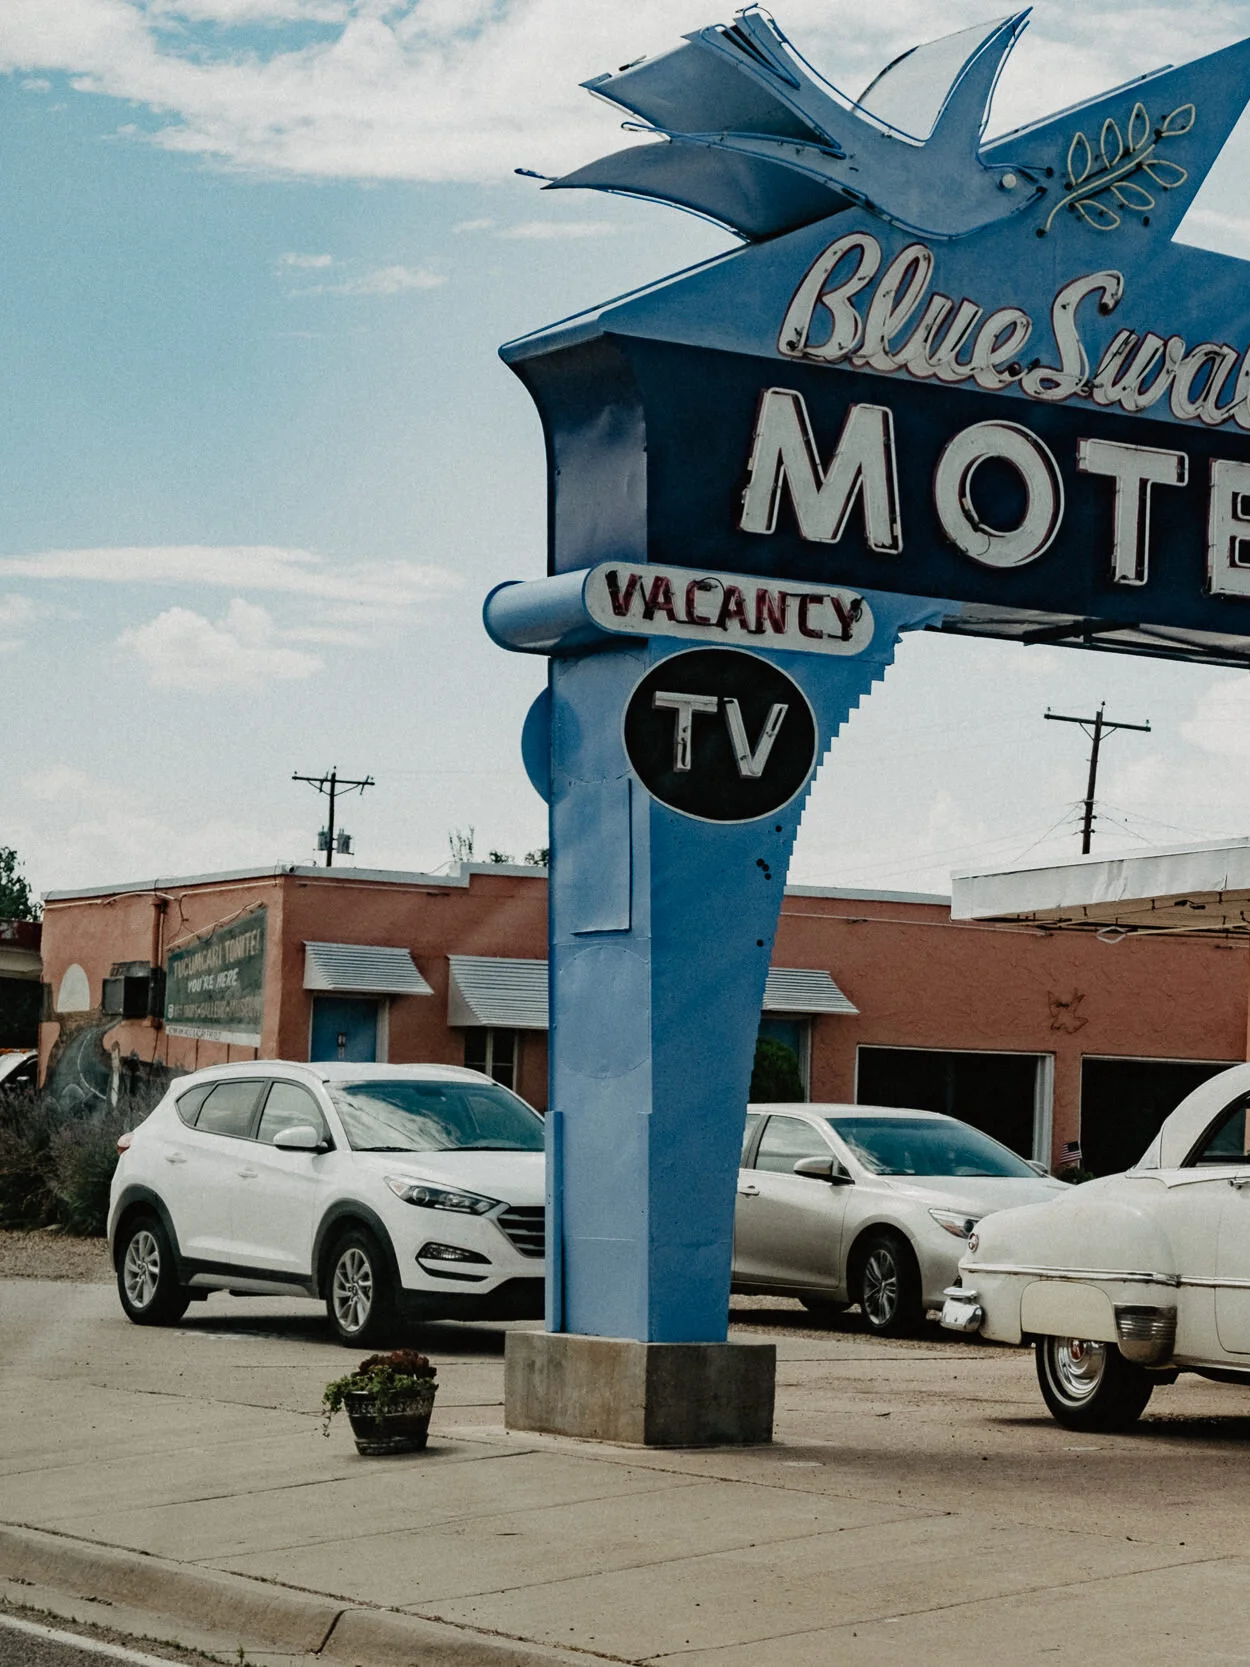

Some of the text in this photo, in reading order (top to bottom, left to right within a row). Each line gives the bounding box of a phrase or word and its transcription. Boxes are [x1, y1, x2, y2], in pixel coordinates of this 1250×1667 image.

[776, 231, 1033, 390] Blue
[605, 570, 865, 642] VACANCY
[652, 691, 789, 779] TV
[173, 944, 222, 980] TUCUMCARI
[215, 968, 239, 988] HERE
